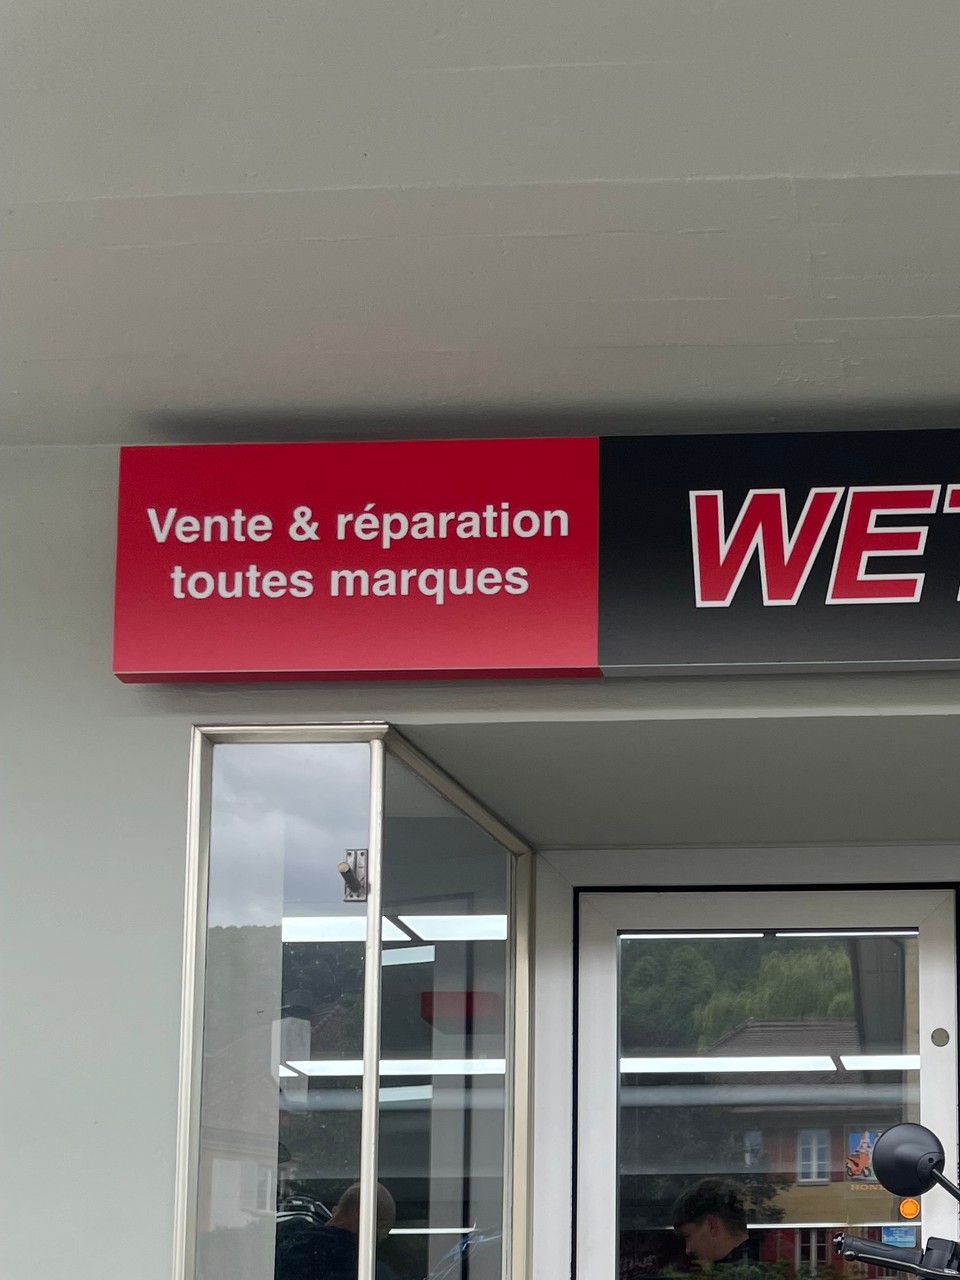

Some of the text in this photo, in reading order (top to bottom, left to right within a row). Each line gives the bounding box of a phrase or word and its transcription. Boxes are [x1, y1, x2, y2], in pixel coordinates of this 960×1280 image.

[147, 500, 571, 549] Vente & réparation
[171, 562, 530, 605] toutes marques
